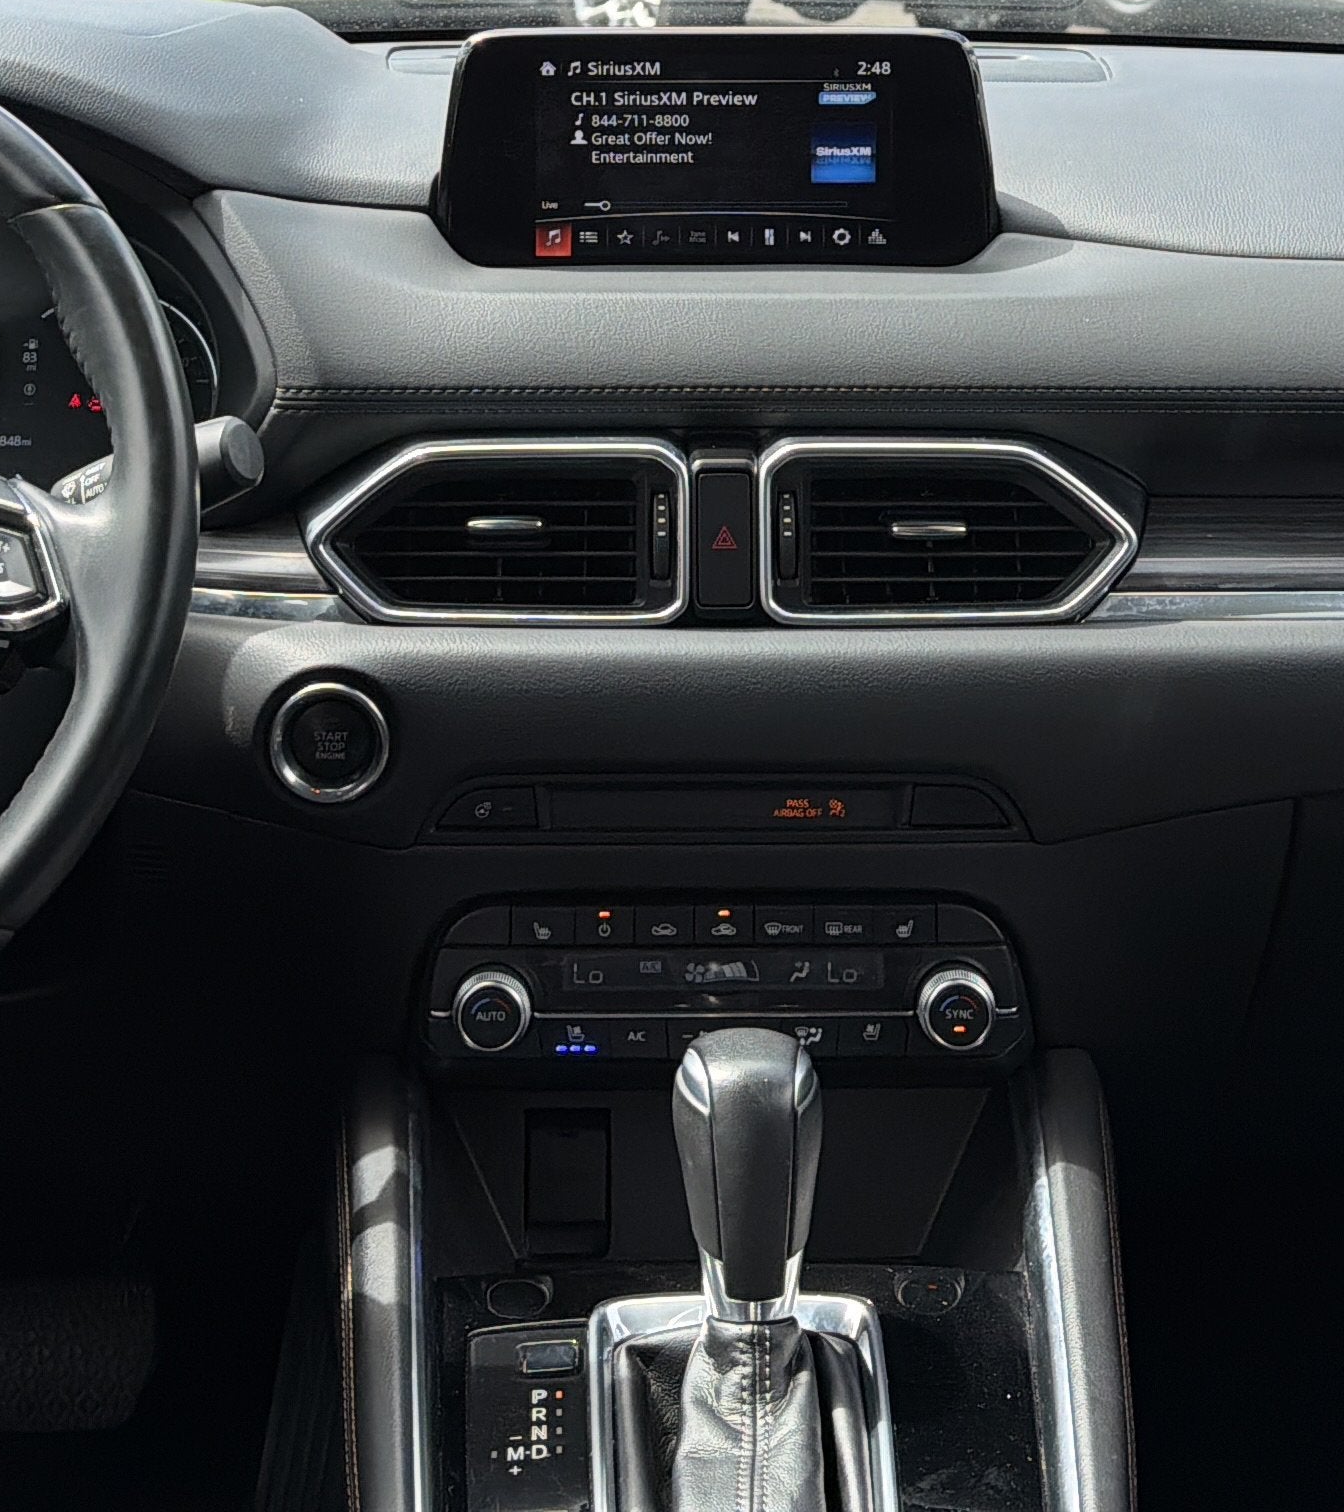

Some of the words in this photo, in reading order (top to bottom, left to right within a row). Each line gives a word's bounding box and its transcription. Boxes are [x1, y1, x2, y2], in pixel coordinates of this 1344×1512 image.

[588, 61, 660, 75] SiriusXM
[857, 61, 891, 75] 2:48
[823, 83, 871, 91] SIRIUSXM
[571, 92, 607, 105] CH.1
[614, 91, 687, 105] SiriusXM
[693, 91, 758, 106] Preview
[591, 114, 690, 127] 844-711-8800
[591, 132, 630, 145] Great
[634, 131, 671, 145] Offer
[675, 132, 712, 145] Now!
[816, 146, 871, 156] SiriusXM
[591, 150, 694, 164] Entertainment
[541, 200, 558, 209] Live
[22, 352, 38, 363] 83
[85, 484, 105, 498] AUTO
[314, 731, 348, 742] START
[317, 742, 346, 751] STOP
[316, 752, 346, 760] ENGINE
[786, 799, 810, 808] PASS
[773, 809, 804, 818] AIRBAG
[806, 809, 823, 817] OFF
[782, 924, 804, 934] FRONT
[844, 925, 863, 934] REAR
[476, 1011, 506, 1022] AUTO
[945, 1008, 974, 1020] SYNC
[627, 1032, 646, 1042] A/C
[531, 1390, 548, 1404] P
[531, 1408, 547, 1422] R
[531, 1425, 548, 1441] N
